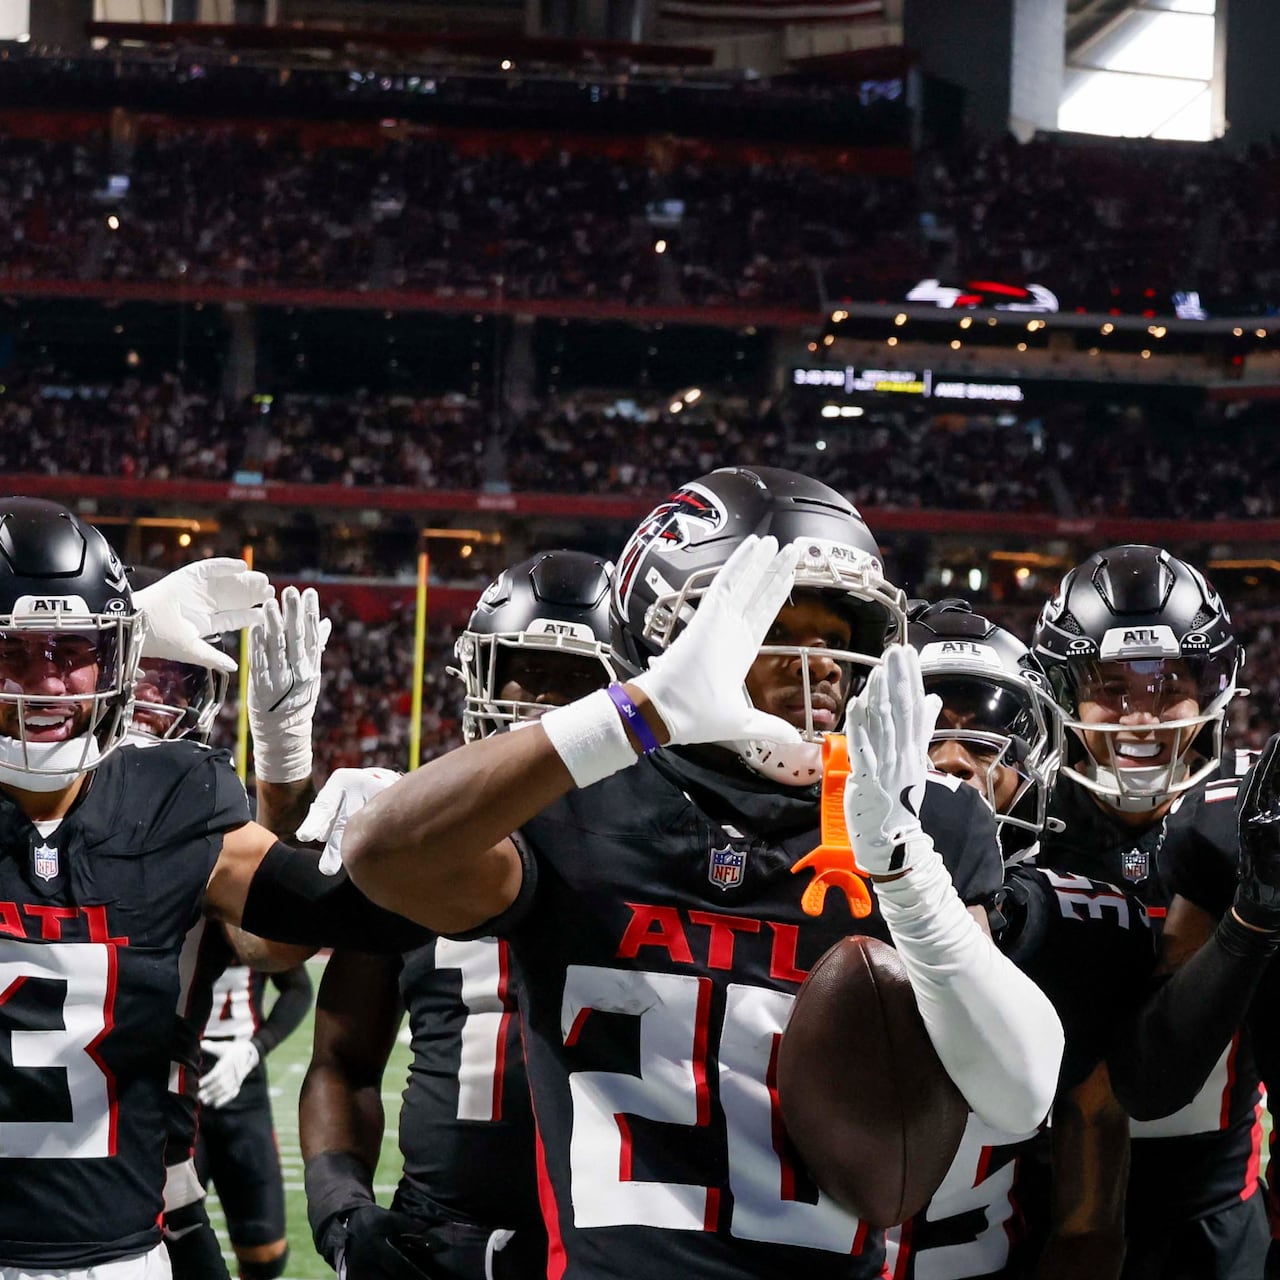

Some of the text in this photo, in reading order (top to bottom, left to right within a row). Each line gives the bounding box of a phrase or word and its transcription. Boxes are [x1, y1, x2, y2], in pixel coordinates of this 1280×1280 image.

[830, 545, 858, 563] ATL
[33, 599, 73, 612] ATL
[543, 621, 580, 638] ATL
[1123, 629, 1160, 643] ATL
[941, 642, 982, 654] ATL
[1065, 647, 1097, 656] OAKLEY
[1181, 642, 1211, 650] OAKLEY
[616, 902, 809, 983] ATL
